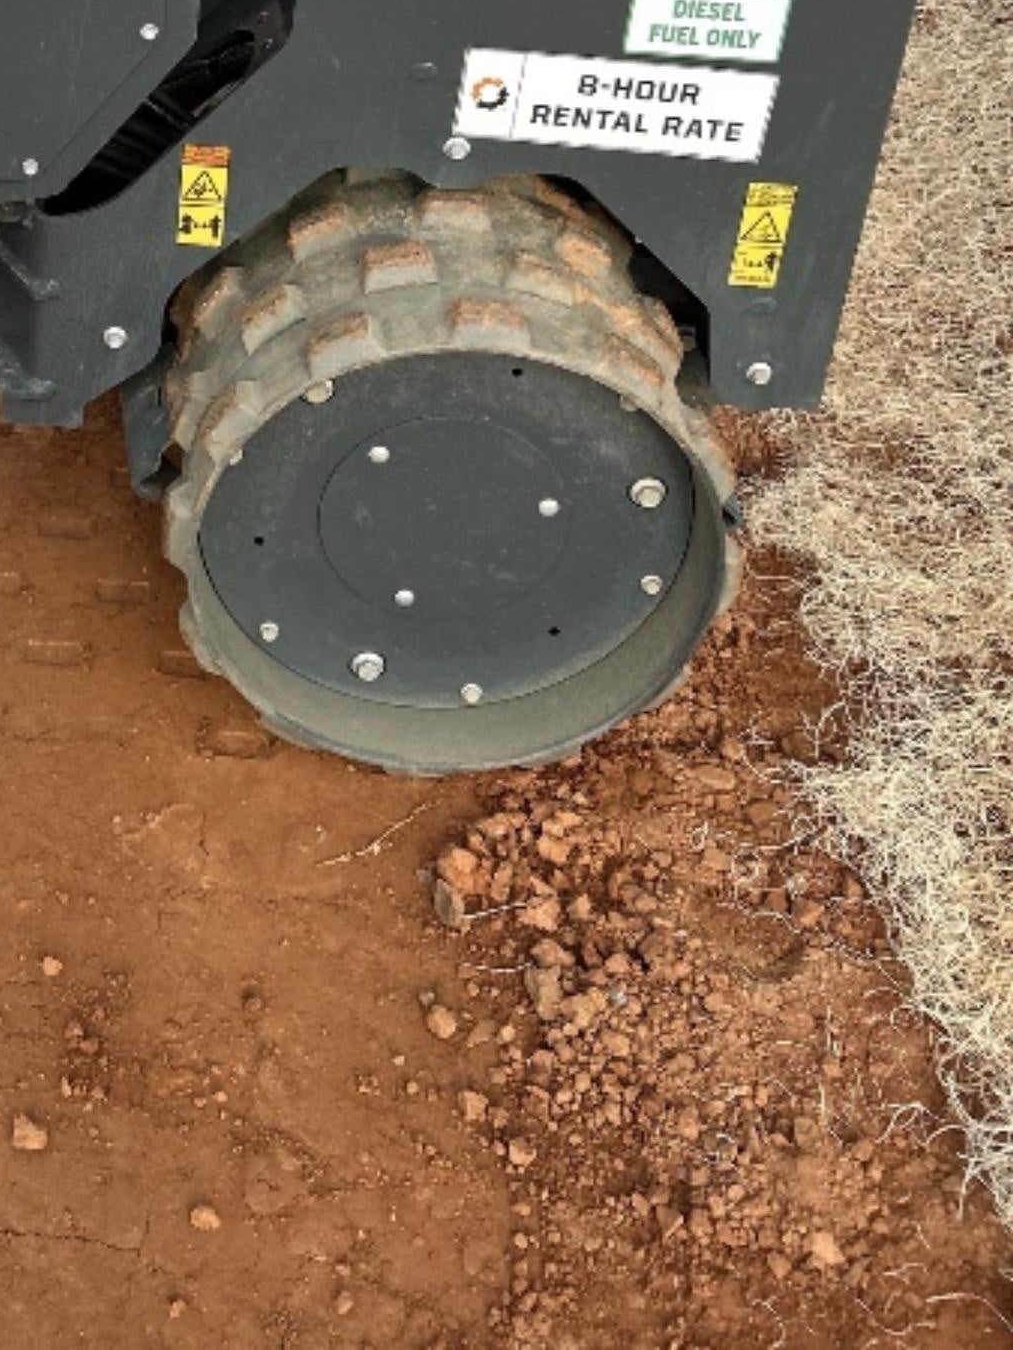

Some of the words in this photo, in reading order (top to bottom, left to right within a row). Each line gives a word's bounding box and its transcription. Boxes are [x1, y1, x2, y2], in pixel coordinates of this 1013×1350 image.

[648, 22, 700, 46] FUEL
[706, 27, 763, 50] ONLY
[577, 73, 702, 107] 8-HOUR
[529, 103, 649, 134] RENTAL
[661, 115, 745, 143] RATE
